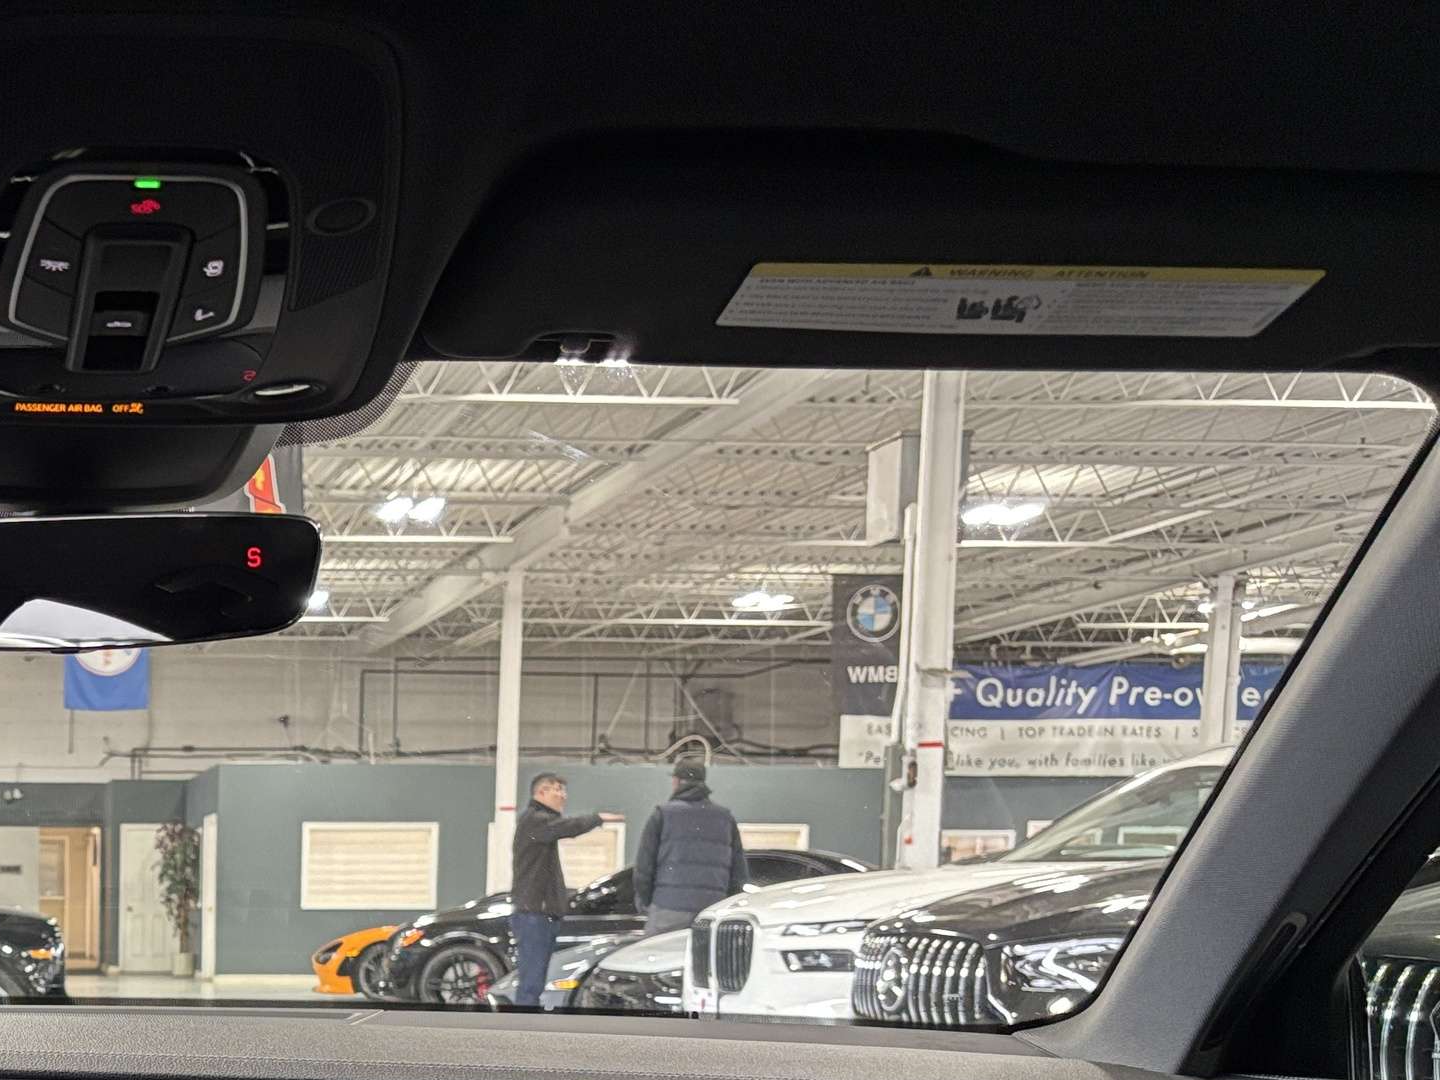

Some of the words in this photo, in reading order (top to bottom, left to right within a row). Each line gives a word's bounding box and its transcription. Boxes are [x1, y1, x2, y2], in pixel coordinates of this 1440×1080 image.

[950, 269, 1034, 278] WARNING
[1056, 270, 1148, 279] ATTENTION
[15, 403, 65, 412] PASSENGER
[67, 404, 82, 412] AIR
[84, 404, 102, 412] BAG
[112, 404, 128, 412] OFF
[247, 547, 261, 568] S
[976, 675, 1098, 715] Quality
[1017, 726, 1046, 738] TOP
[1121, 726, 1162, 738] RATES
[956, 753, 983, 768] like
[1028, 752, 1058, 768] with
[1065, 752, 1125, 769] families
[1131, 752, 1157, 768] like
